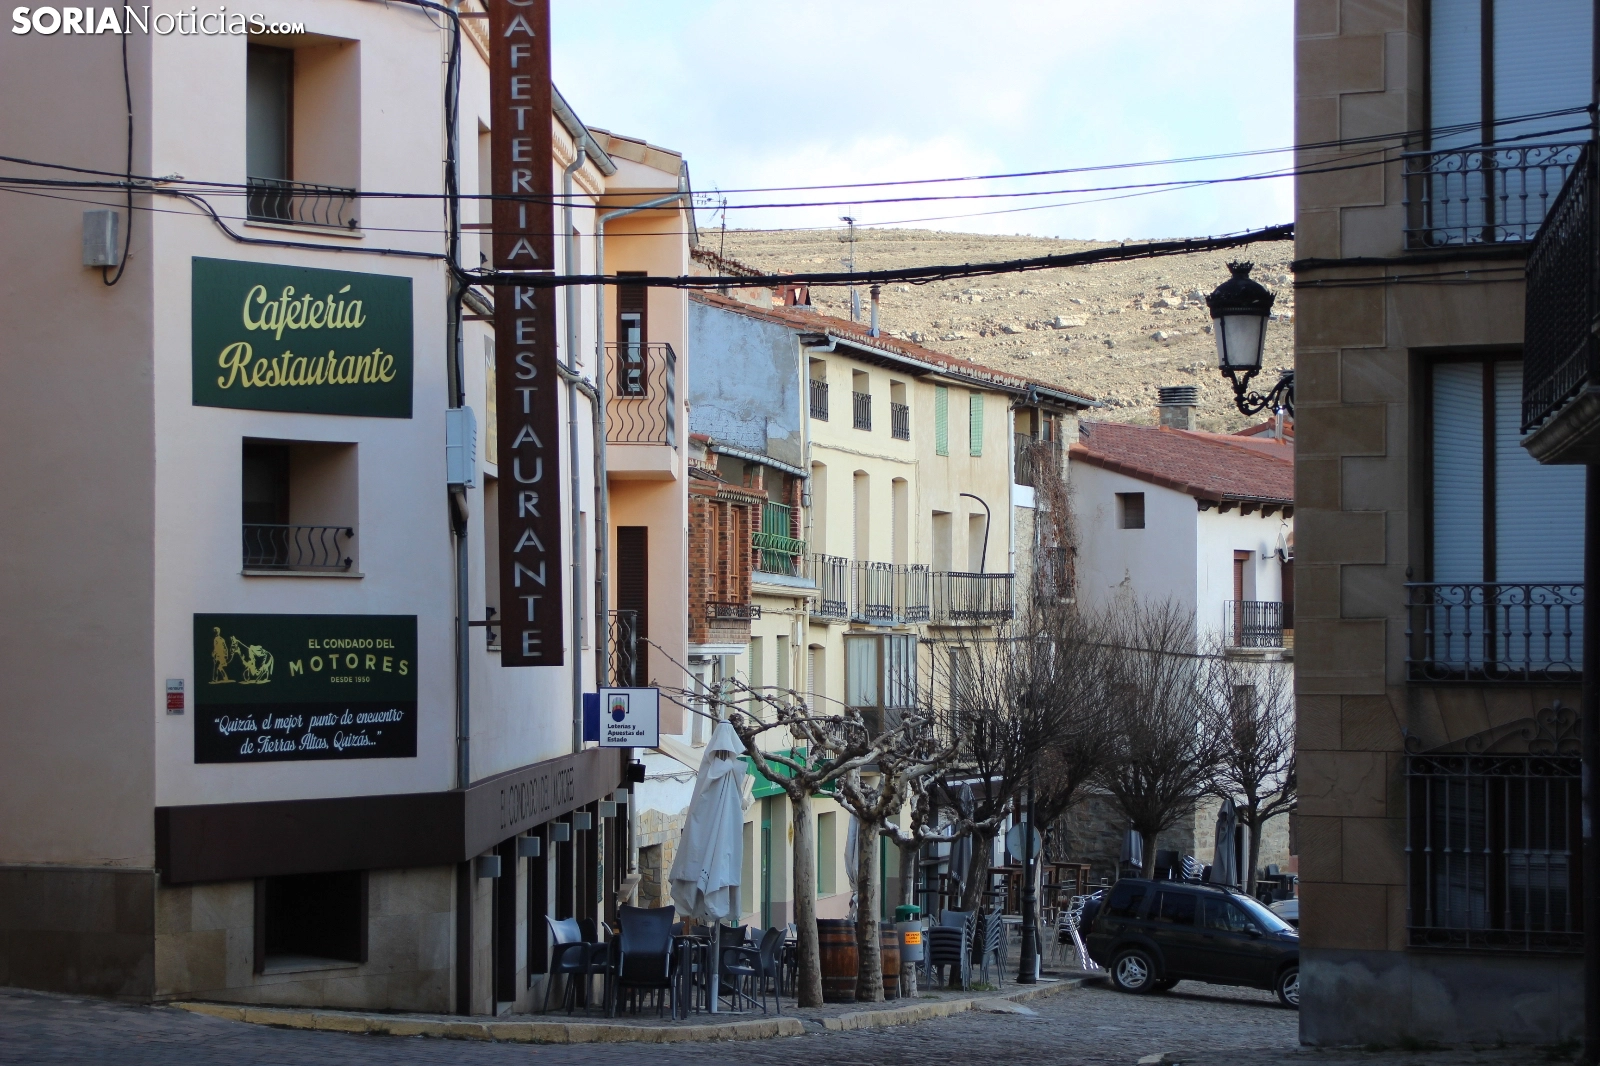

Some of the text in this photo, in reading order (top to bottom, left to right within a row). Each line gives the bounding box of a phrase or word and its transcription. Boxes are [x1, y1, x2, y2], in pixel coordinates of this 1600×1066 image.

[242, 284, 366, 341] Cafetería
[217, 341, 397, 390] Restaurante
[511, 280, 546, 657] RESTAURANTE
[308, 638, 395, 649] EL CONDADO DEL
[289, 653, 409, 677] MOTORES
[262, 713, 272, 730] el
[274, 714, 304, 734] mejor
[308, 711, 339, 733] punto
[340, 709, 354, 726] de
[356, 708, 405, 725] encuentro
[240, 738, 254, 755] de
[257, 735, 296, 754] Tierras
[298, 732, 329, 751] Altas,
